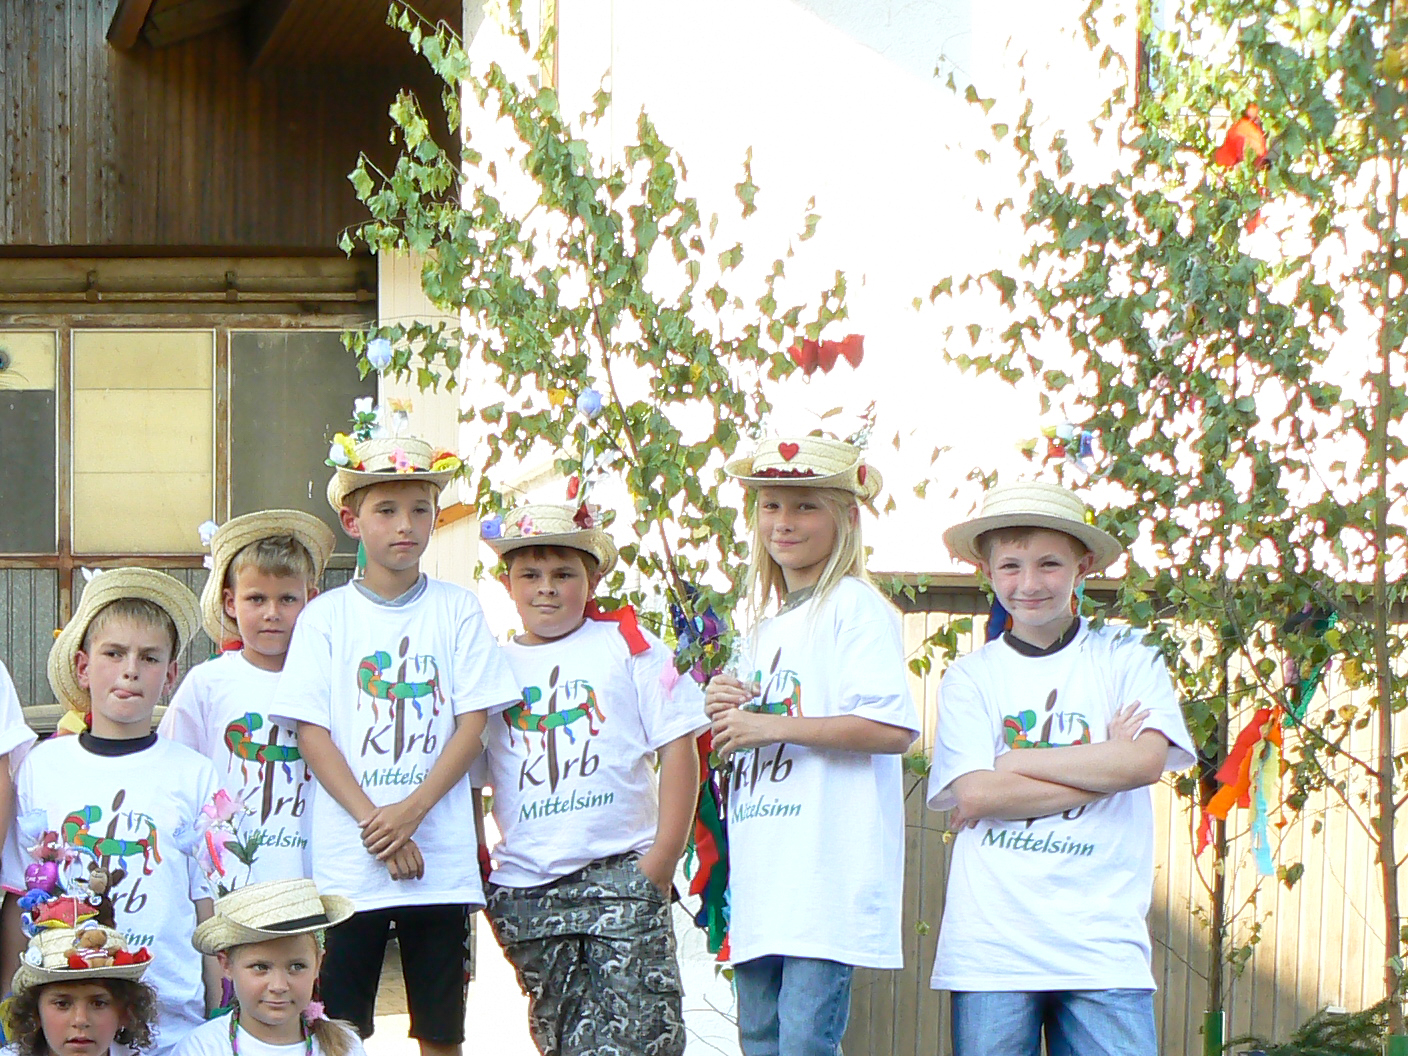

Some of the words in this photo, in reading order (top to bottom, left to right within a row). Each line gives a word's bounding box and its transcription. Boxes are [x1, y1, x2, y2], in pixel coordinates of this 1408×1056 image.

[360, 764, 430, 788] Mittelsi
[518, 789, 614, 823] Mittelsinn
[981, 828, 1095, 857] Mittelsinn
